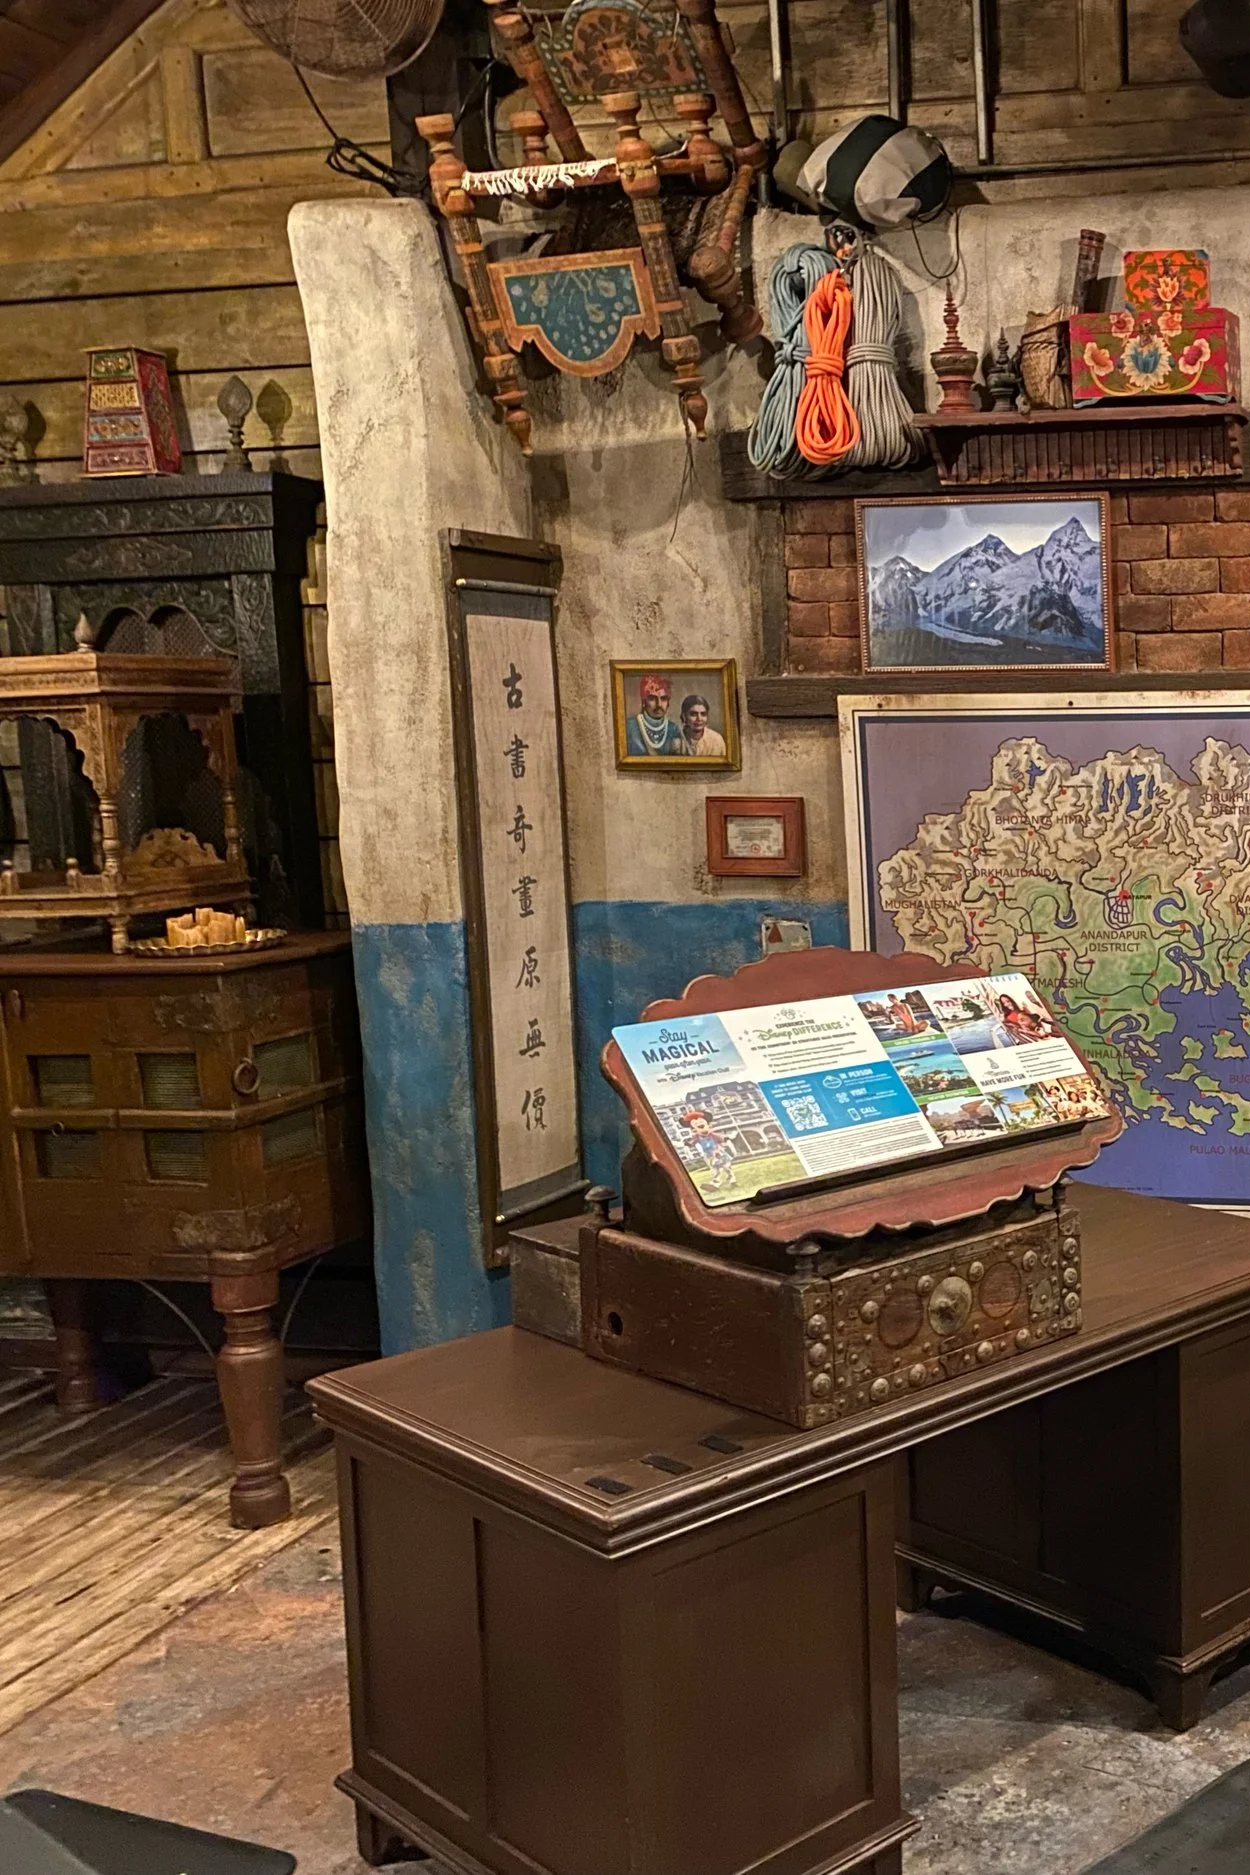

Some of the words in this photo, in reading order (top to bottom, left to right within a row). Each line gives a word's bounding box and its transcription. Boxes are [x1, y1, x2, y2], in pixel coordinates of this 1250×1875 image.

[1080, 930, 1148, 940] ANANDAPUR
[1088, 943, 1141, 952] DISTRICT
[659, 1028, 688, 1044] Stay
[752, 1028, 793, 1042] Disney
[793, 1021, 843, 1036] DIFFERENCE
[641, 1040, 720, 1064] MAGICAL
[860, 1105, 877, 1114] CALL
[1189, 1145, 1225, 1155] PULAO
